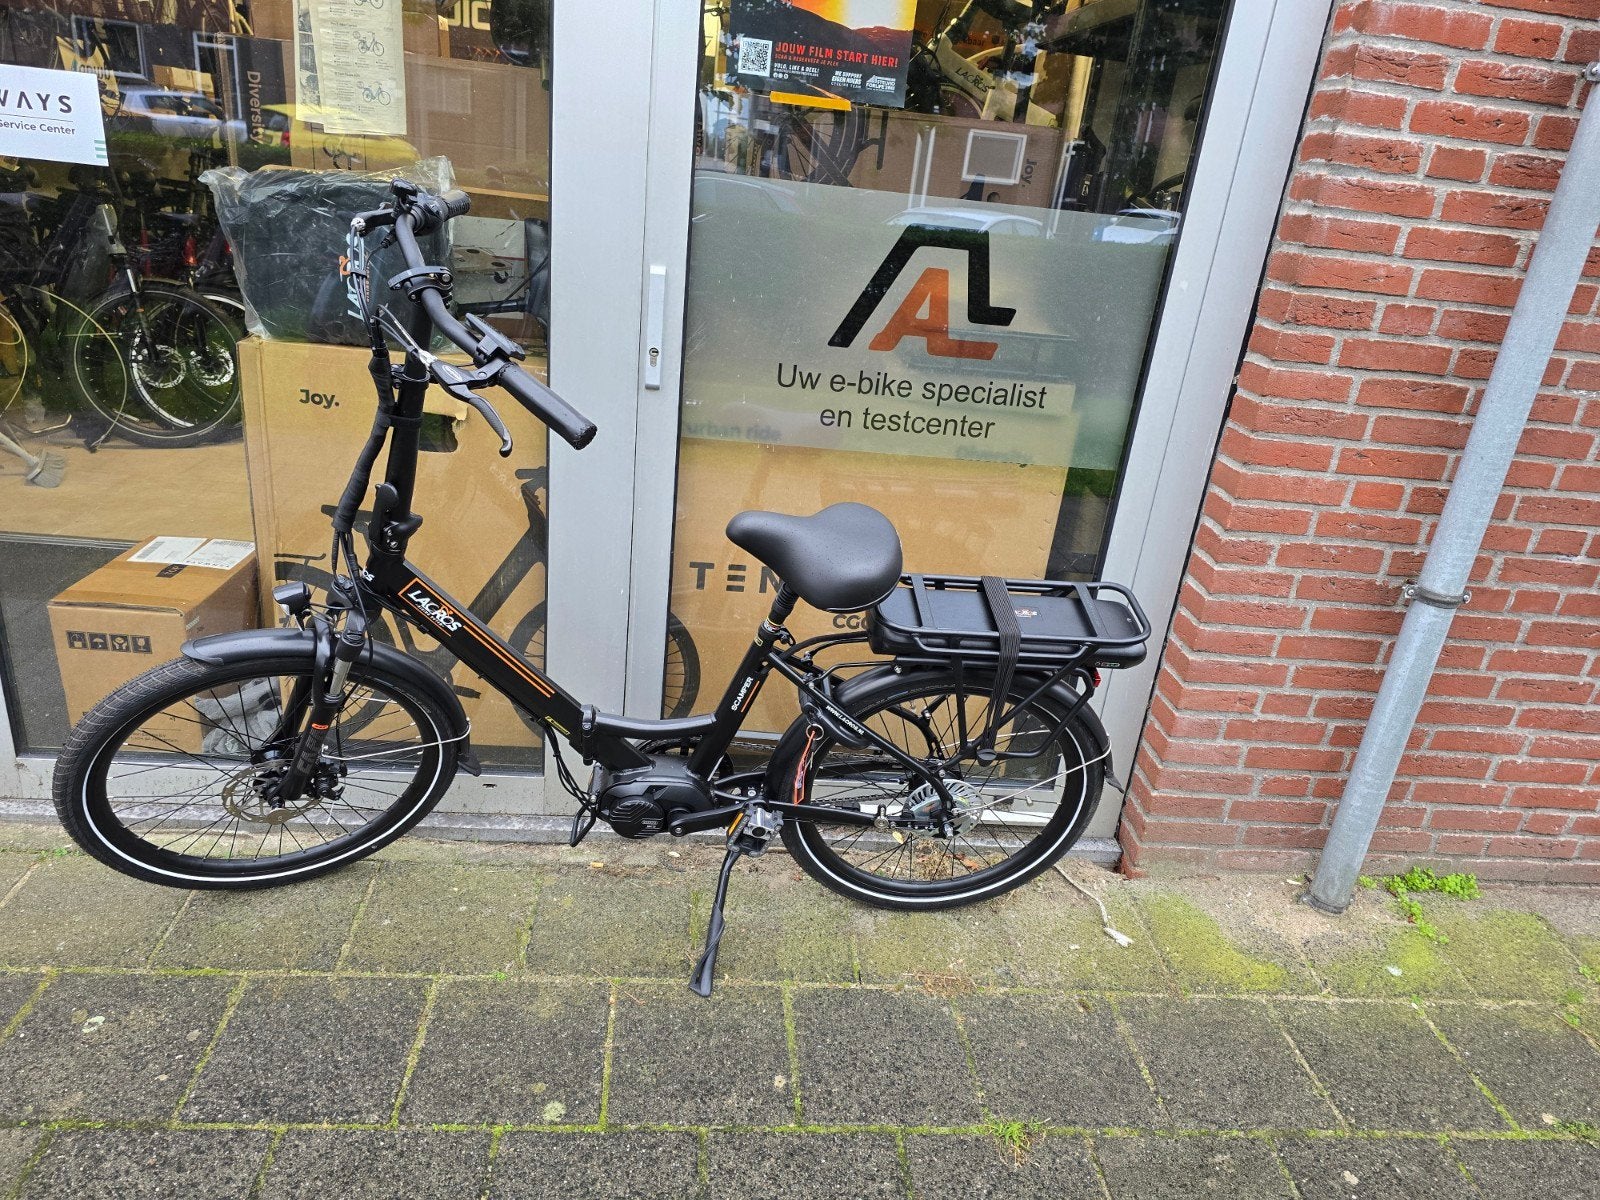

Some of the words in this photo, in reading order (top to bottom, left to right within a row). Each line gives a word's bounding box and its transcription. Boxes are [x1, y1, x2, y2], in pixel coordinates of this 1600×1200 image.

[776, 42, 806, 56] JOUW
[809, 46, 833, 59] FILM
[837, 49, 868, 64] START
[872, 54, 899, 68] HIER!
[955, 67, 991, 93] LACROS
[39, 123, 76, 135] Center
[1022, 158, 1037, 188] Joy.
[299, 388, 340, 410] Joy.
[776, 362, 822, 390] Uw
[829, 370, 913, 398] e-bike
[921, 381, 1048, 409] specialist
[819, 408, 852, 428] en
[862, 407, 996, 439] testcenter
[407, 589, 463, 632] LACROS
[730, 676, 754, 712] SCAMPER
